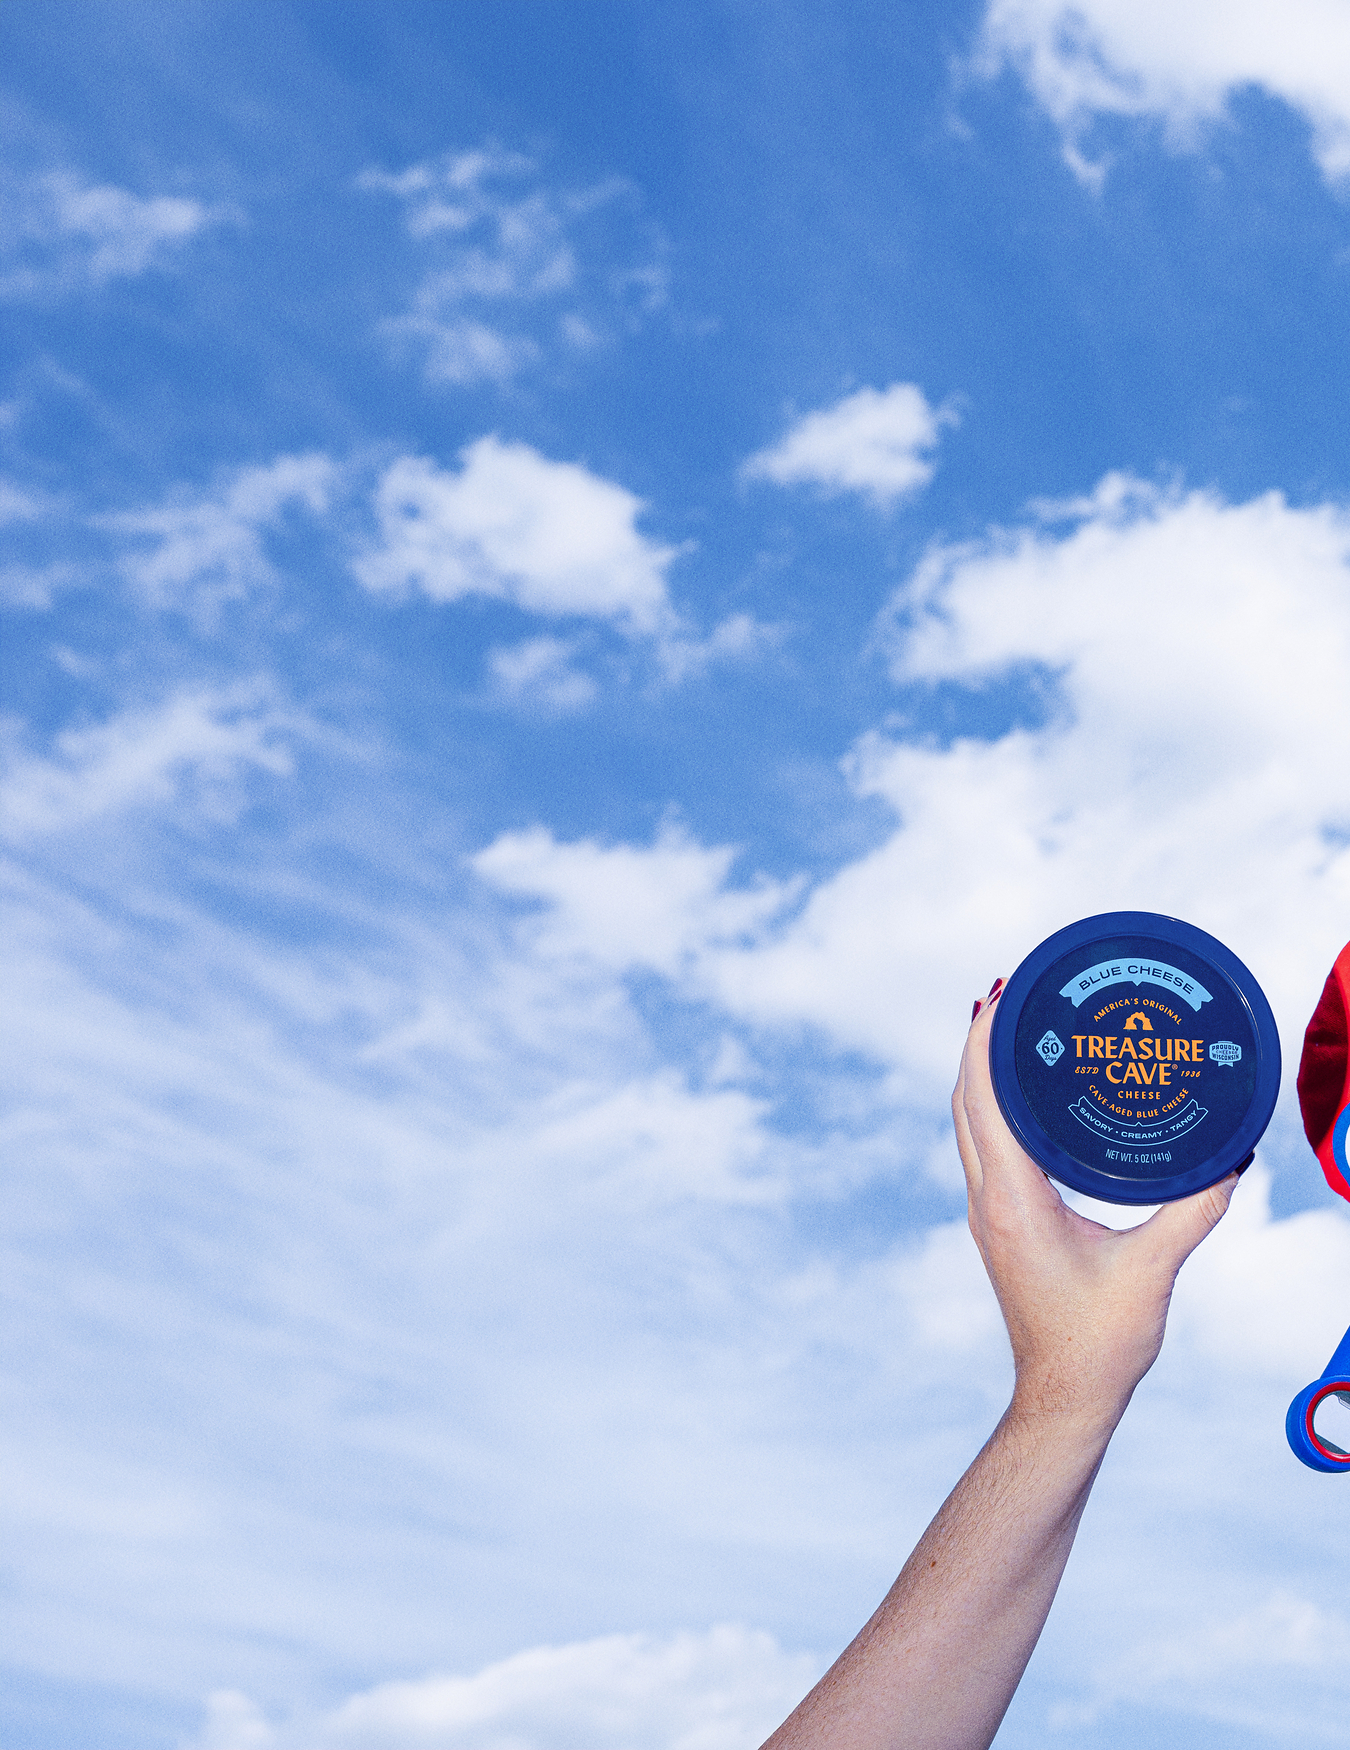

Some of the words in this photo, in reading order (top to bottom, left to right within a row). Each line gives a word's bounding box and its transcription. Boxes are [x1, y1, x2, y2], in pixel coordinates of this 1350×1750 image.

[1078, 966, 1122, 991] BLUE
[1127, 965, 1195, 995] CHEESE
[1093, 997, 1139, 1023] AMERICA'S
[1142, 998, 1182, 1026] ORIGINAL
[1041, 1041, 1060, 1055] 60
[1070, 1034, 1205, 1062] TREASURE
[1074, 1065, 1100, 1075] ESTD
[1180, 1070, 1201, 1078] 1936
[1088, 1084, 1133, 1117] CAVE-AGED
[1136, 1108, 1160, 1119] BLUE
[1161, 1087, 1189, 1113] CHEESE
[1117, 1090, 1161, 1100] CHEESE
[1079, 1107, 1114, 1133] SAVORY
[1120, 1130, 1163, 1139] CREAMY
[1169, 1109, 1198, 1132] TANGY
[1105, 1148, 1120, 1160] NET
[1120, 1152, 1133, 1163] WT.
[1134, 1154, 1140, 1164] 5
[1140, 1153, 1150, 1164] OZ
[1150, 1150, 1172, 1164] (141g)
